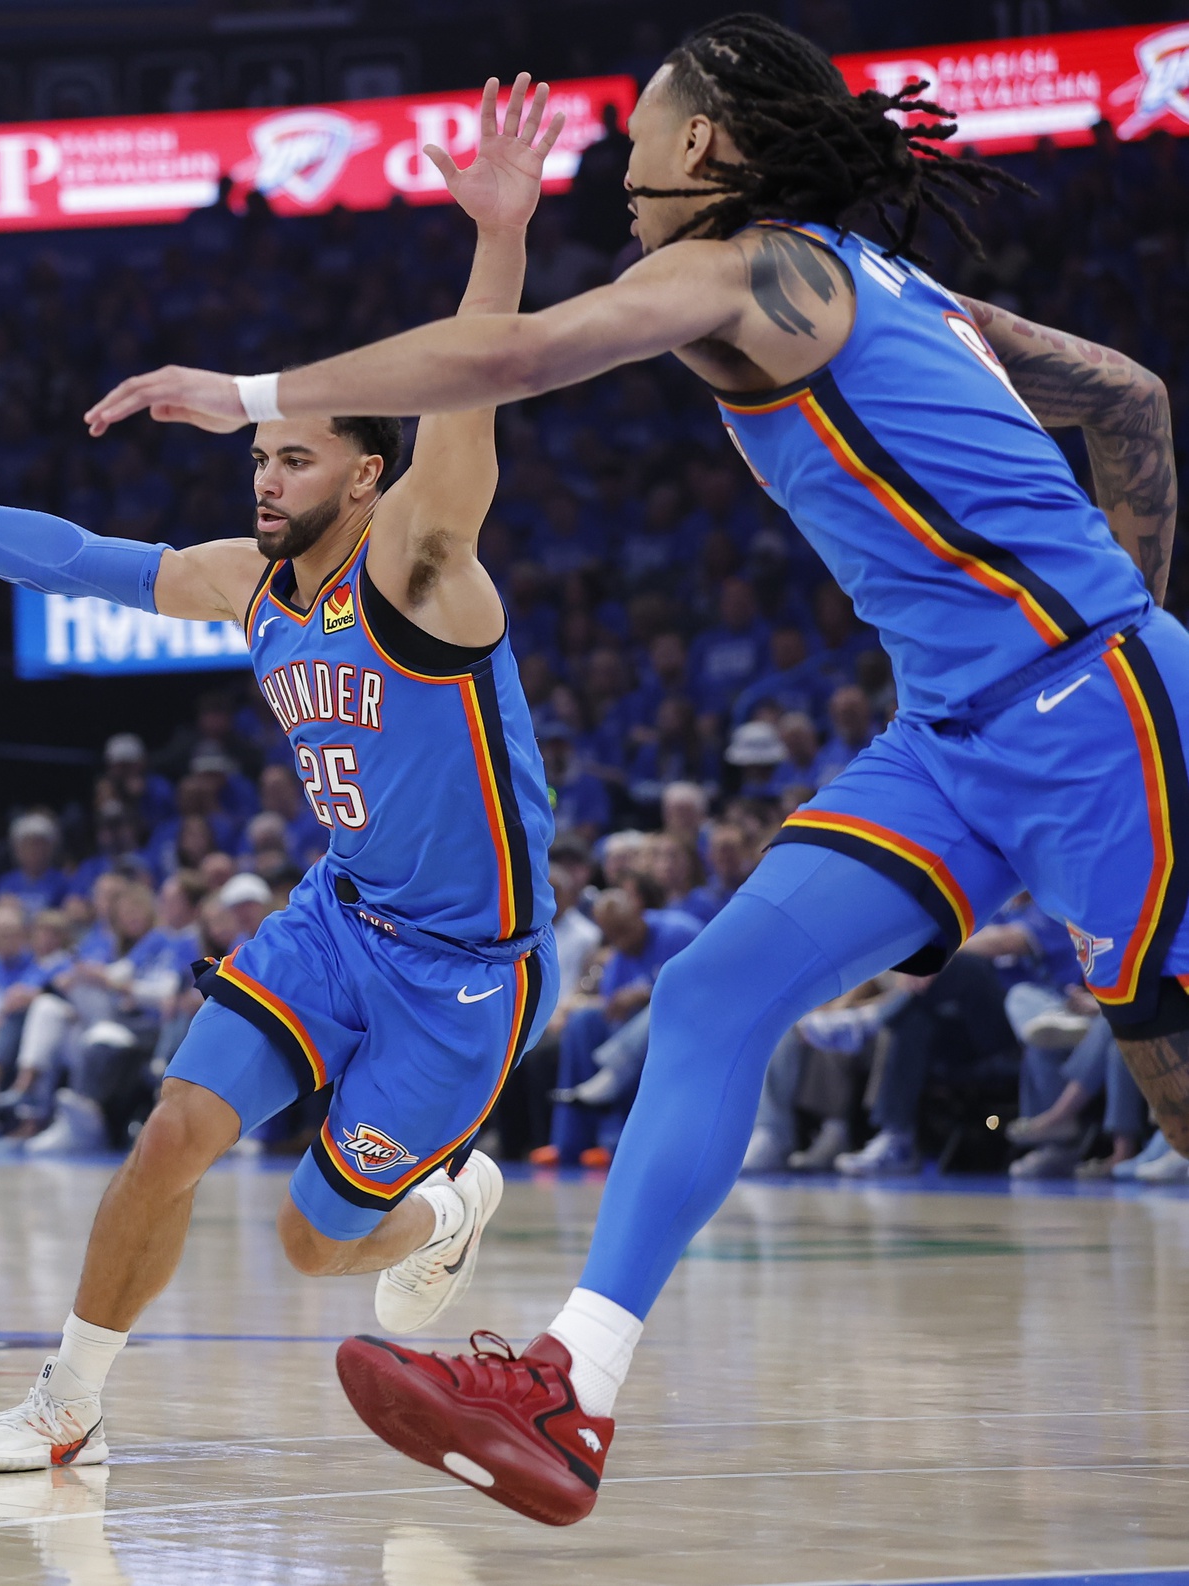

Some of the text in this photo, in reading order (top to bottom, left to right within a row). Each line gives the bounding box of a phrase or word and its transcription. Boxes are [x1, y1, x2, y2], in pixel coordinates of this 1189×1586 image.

[262, 660, 385, 732] HUNDER
[297, 743, 370, 830] 25
[346, 1138, 396, 1159] OKC
